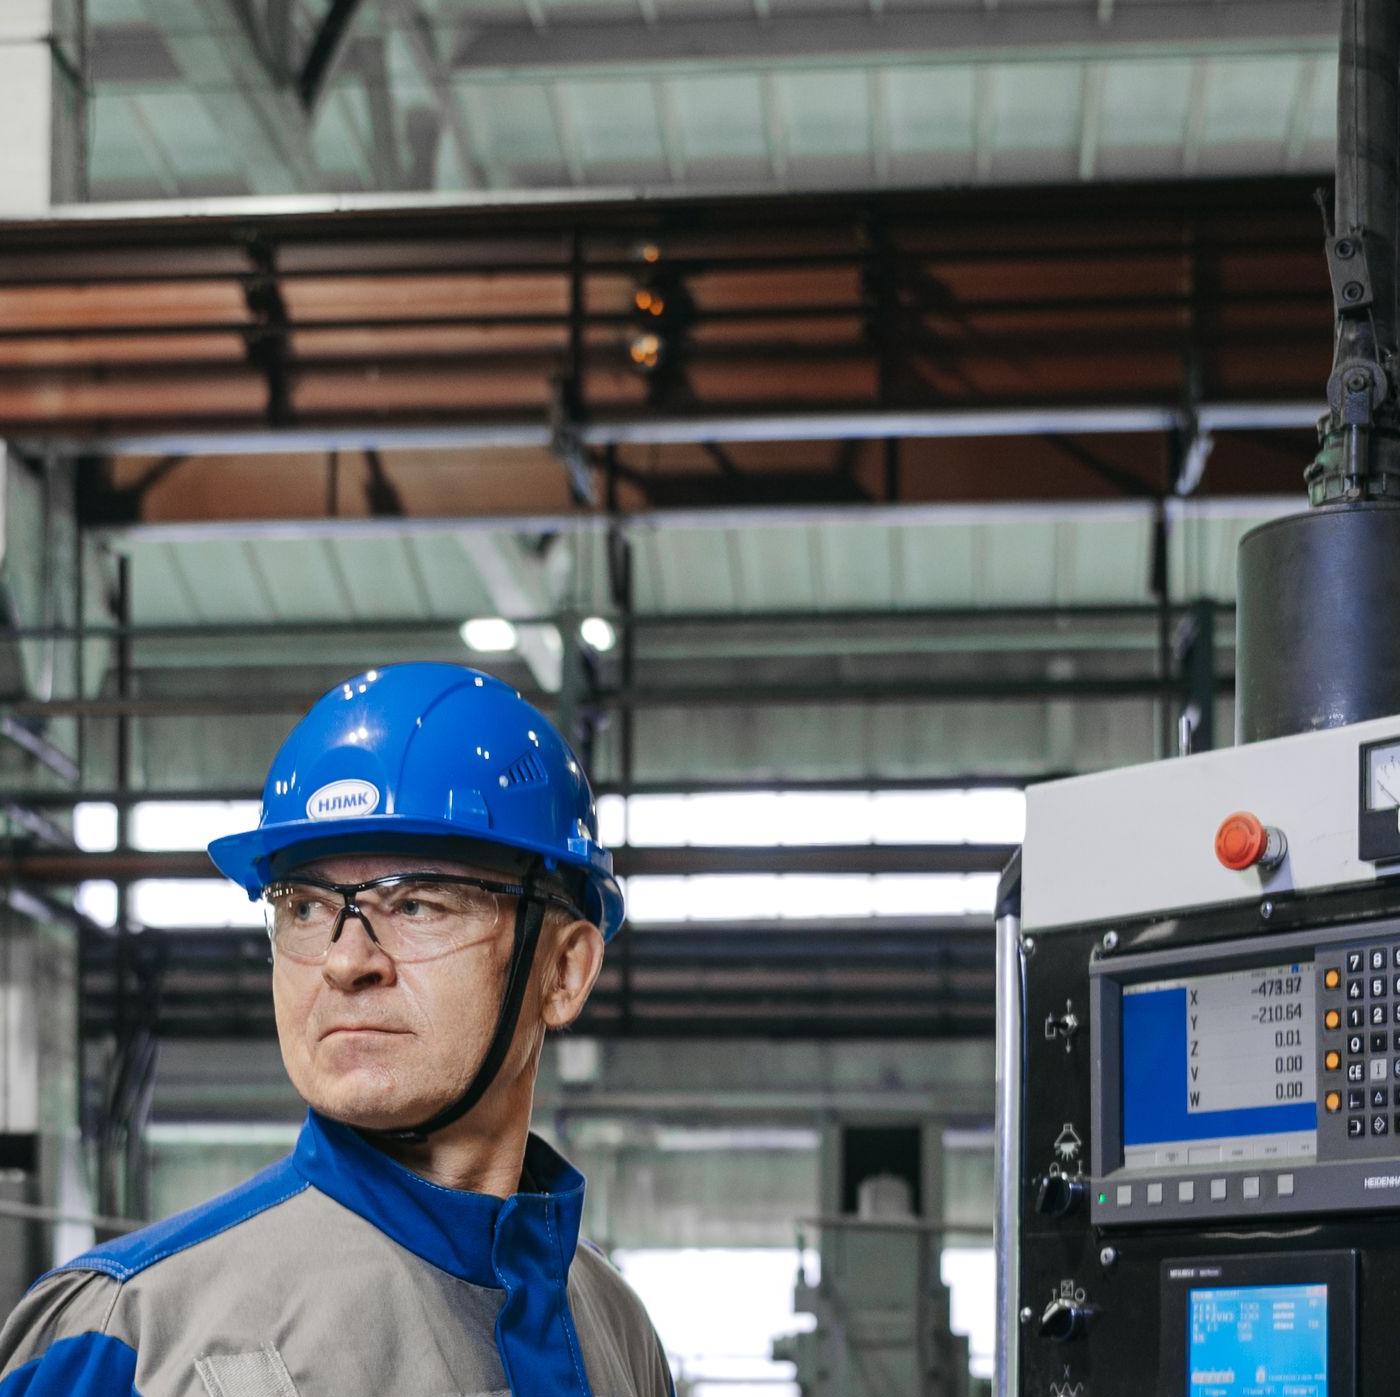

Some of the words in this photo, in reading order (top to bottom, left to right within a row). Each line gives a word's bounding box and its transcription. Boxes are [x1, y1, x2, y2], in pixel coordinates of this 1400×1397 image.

[318, 790, 369, 812] НЛМК
[1350, 954, 1359, 970] 7
[1373, 952, 1382, 968] 8
[1350, 982, 1359, 998] 4
[1373, 980, 1382, 996] 5
[1190, 990, 1198, 1006] X
[1190, 1015, 1198, 1031] Y
[1252, 1003, 1302, 1024] -210.64
[1352, 1010, 1358, 1025] 1
[1373, 1007, 1382, 1023] 2
[1191, 1040, 1199, 1057] Z
[1275, 1030, 1302, 1048] 0.01
[1351, 1037, 1360, 1053] 0
[1191, 1066, 1199, 1082] V
[1275, 1055, 1303, 1074] 0.00
[1349, 1064, 1362, 1080] CE
[1190, 1091, 1200, 1108] W
[1276, 1081, 1303, 1100] 0.00
[1064, 1363, 1071, 1379] X
